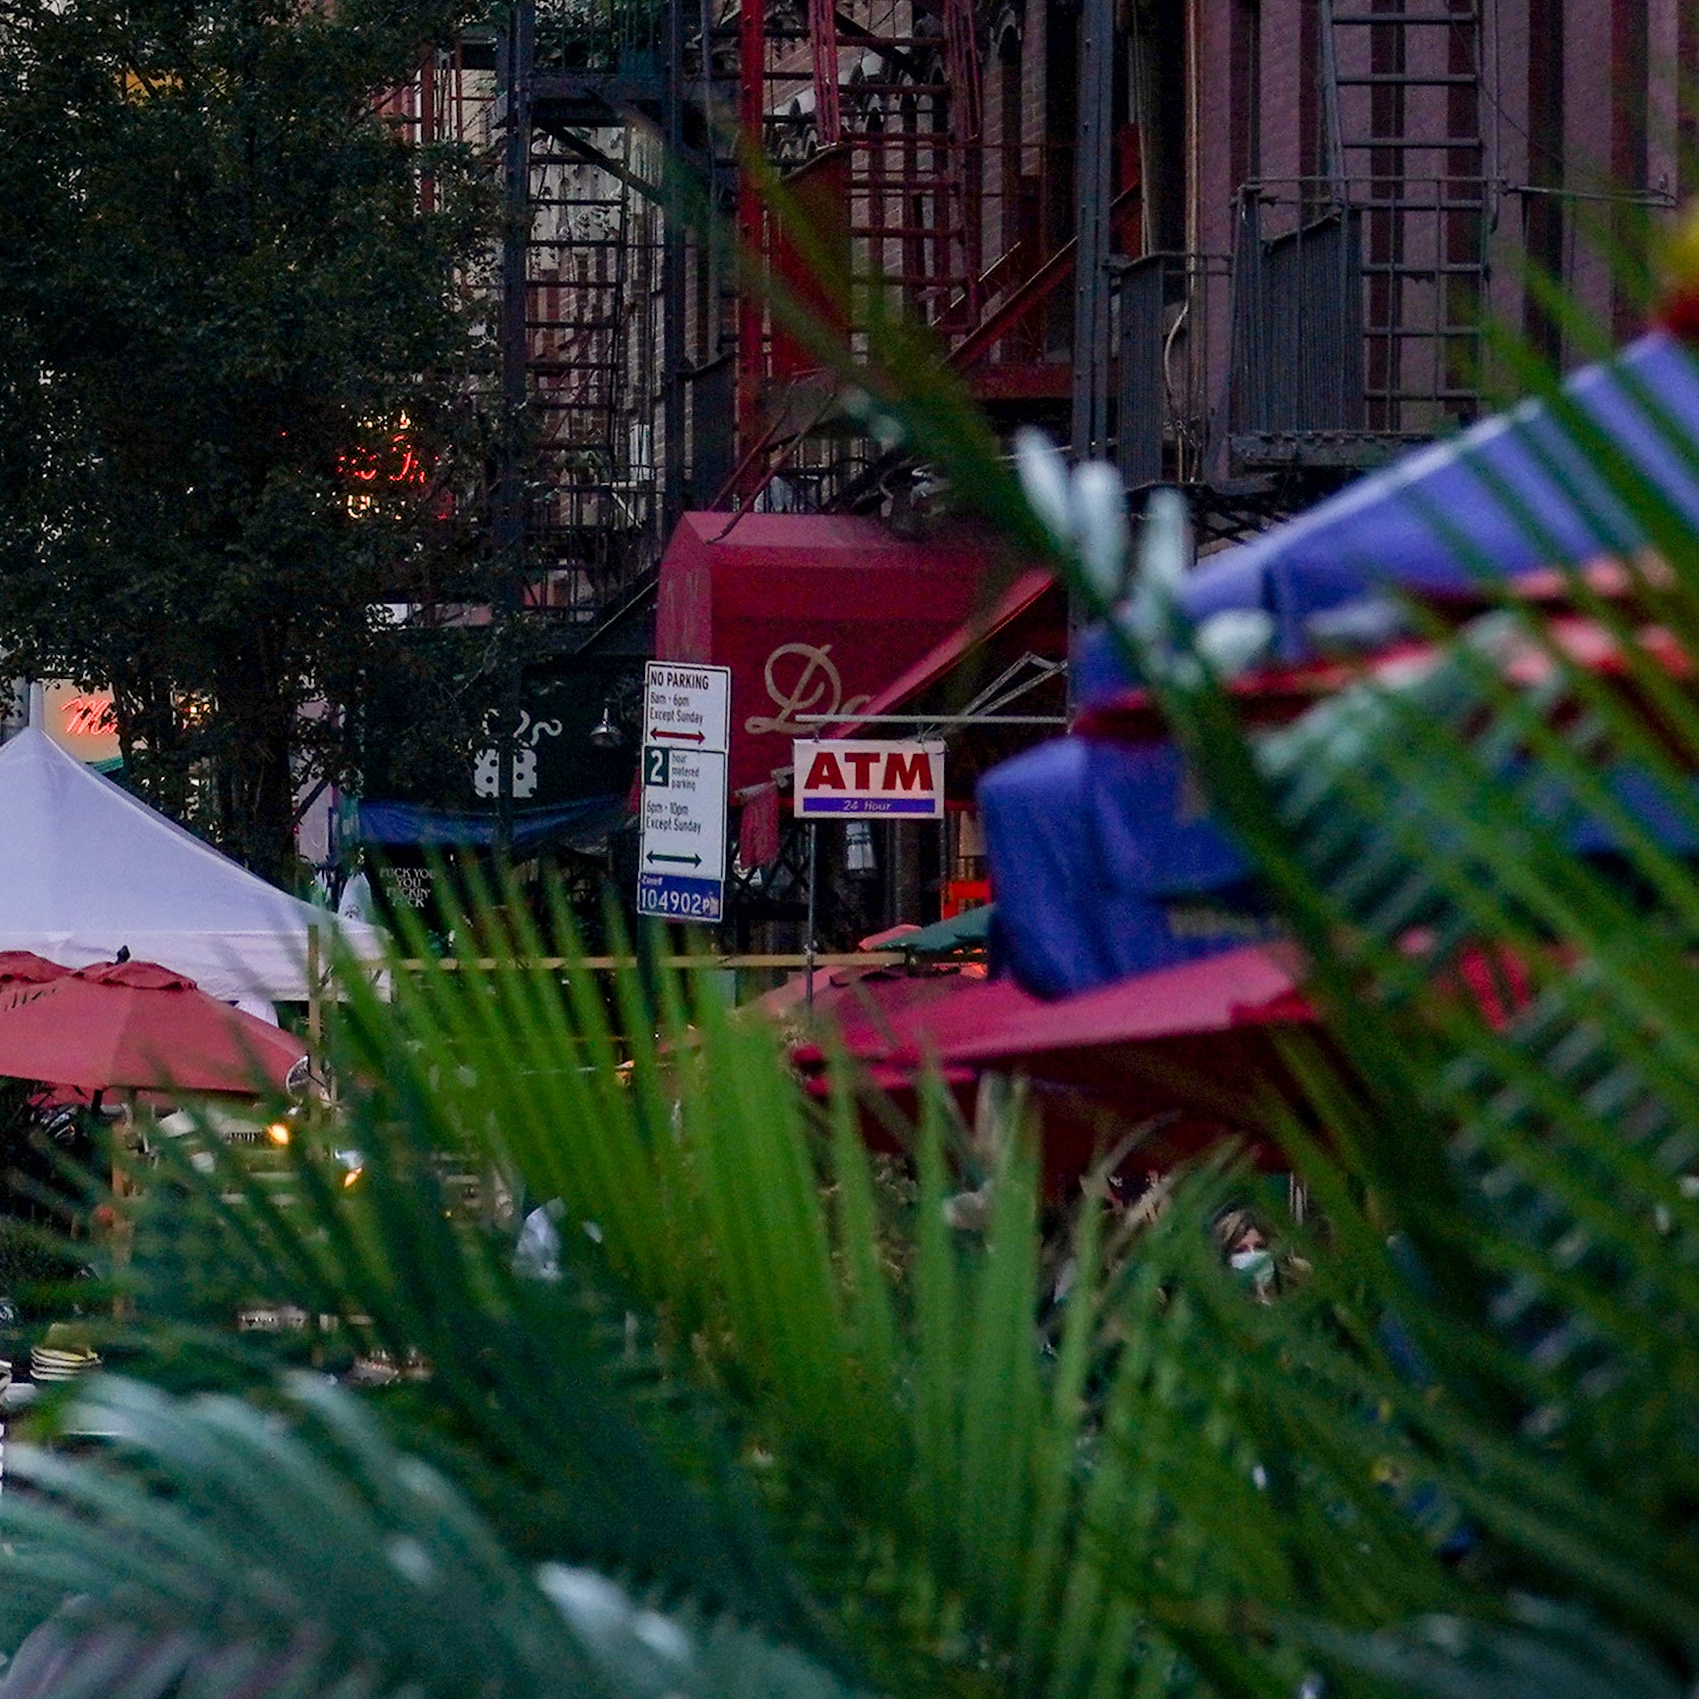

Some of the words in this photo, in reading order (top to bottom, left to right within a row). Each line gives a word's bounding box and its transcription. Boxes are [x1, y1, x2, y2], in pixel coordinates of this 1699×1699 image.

[651, 671, 664, 686] NO
[667, 672, 709, 690] PARKING
[650, 707, 675, 723] Except
[676, 709, 704, 726] Sunday
[650, 750, 664, 783] 2
[804, 752, 934, 791] ATM
[669, 802, 689, 818] 10pm
[843, 801, 858, 811] 24
[863, 801, 891, 811] Hour
[646, 818, 673, 833] Except
[674, 819, 702, 835] Sunday
[396, 877, 421, 888] YOU
[641, 888, 702, 915] 104902
